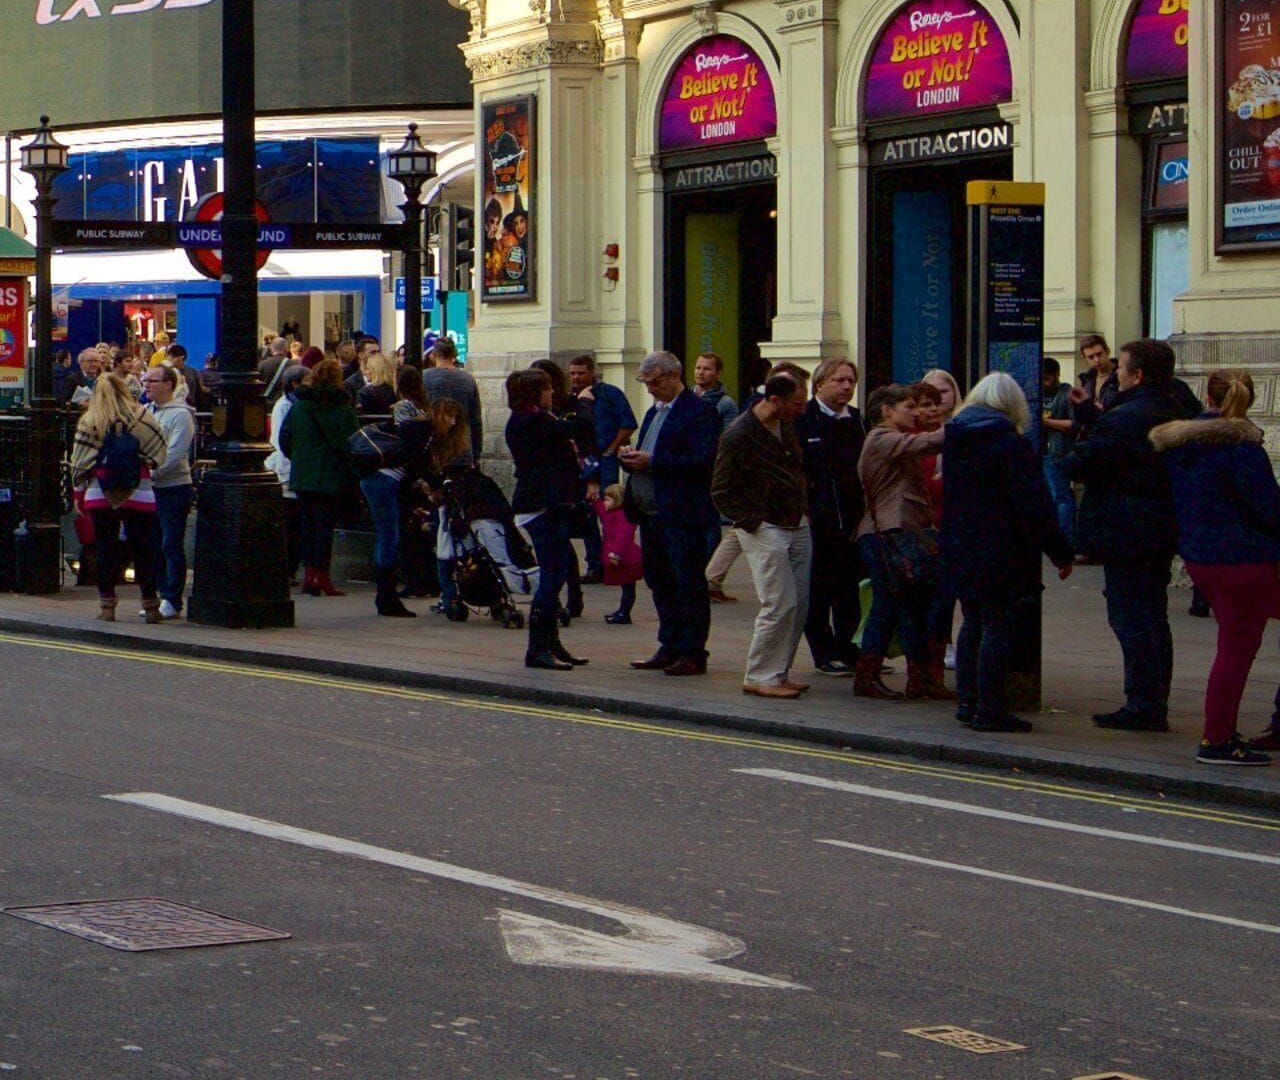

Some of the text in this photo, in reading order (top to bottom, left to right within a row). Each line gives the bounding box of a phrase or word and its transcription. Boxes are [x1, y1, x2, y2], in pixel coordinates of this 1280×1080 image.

[1239, 11, 1251, 33] 2
[1256, 21, 1272, 37] £1
[890, 19, 988, 63] Believe It
[680, 63, 758, 99] Believe It
[902, 52, 975, 90] or Not!
[690, 89, 748, 123] or Not!
[917, 86, 960, 108] LONDON
[701, 120, 736, 140] LONDON
[883, 125, 1008, 161] ATTRACTION
[1228, 146, 1263, 158] CHILL
[676, 158, 774, 187] ATTRACTION
[1229, 156, 1261, 171] OUT
[76, 229, 145, 239] PUBLIC SUBWAY
[180, 228, 286, 242] UNDEUND
[316, 232, 382, 241] PUBLIC SUBWAY
